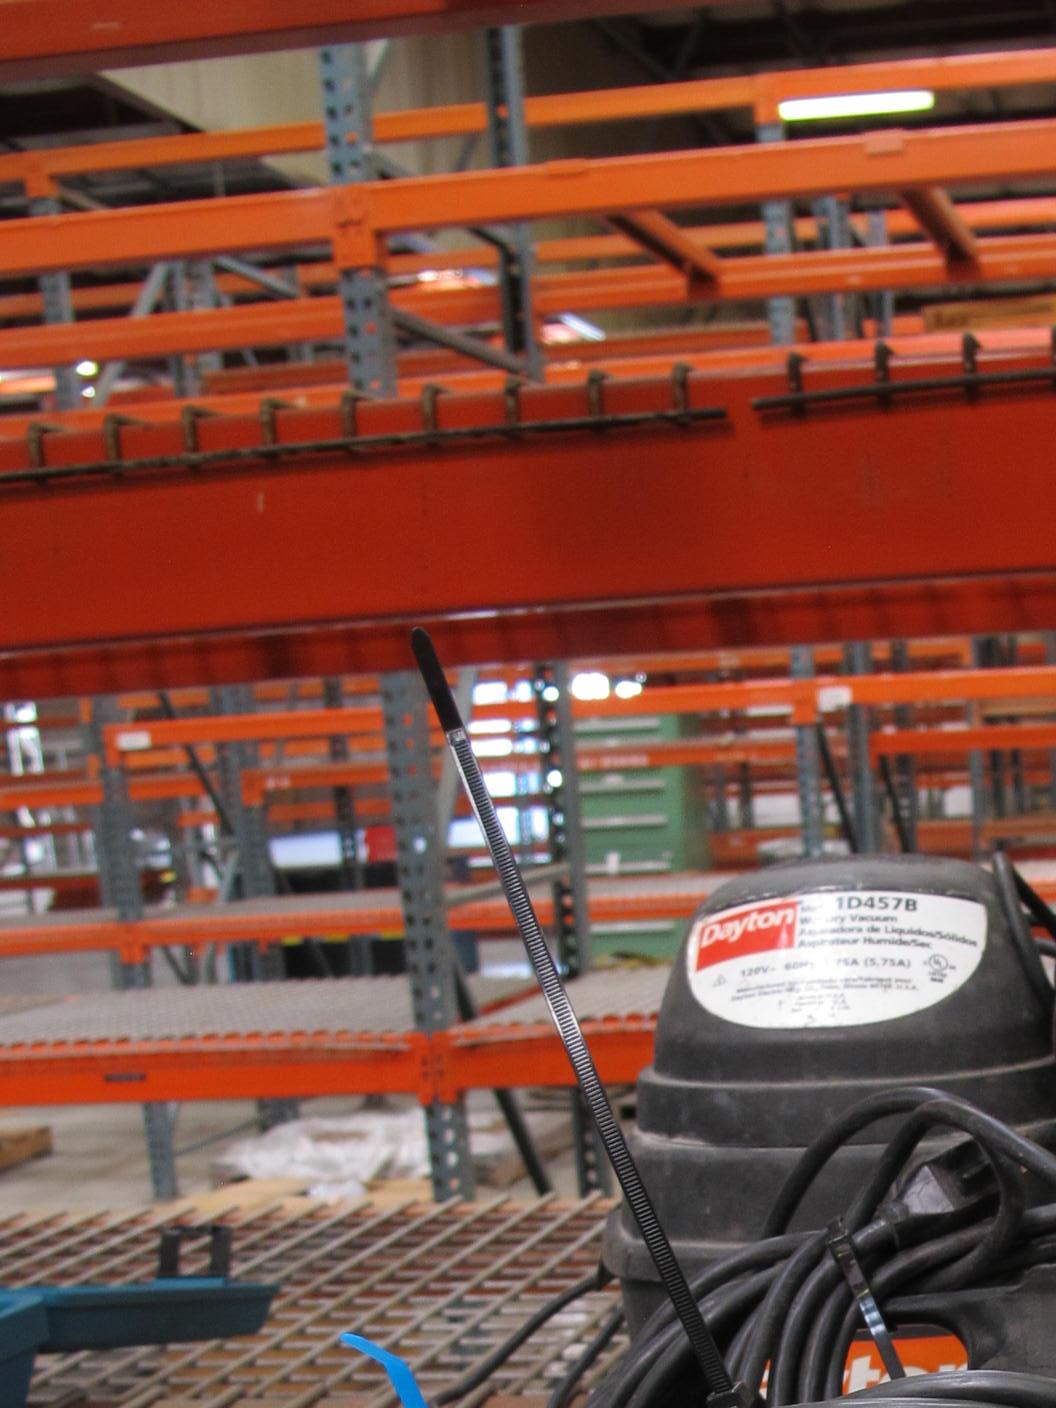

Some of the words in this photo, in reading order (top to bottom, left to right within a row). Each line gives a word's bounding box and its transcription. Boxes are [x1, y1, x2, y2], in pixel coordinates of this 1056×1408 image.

[837, 896, 917, 911] 1D457B
[850, 914, 897, 922] Vacuum
[701, 905, 795, 948] Dayton
[867, 925, 881, 934] de
